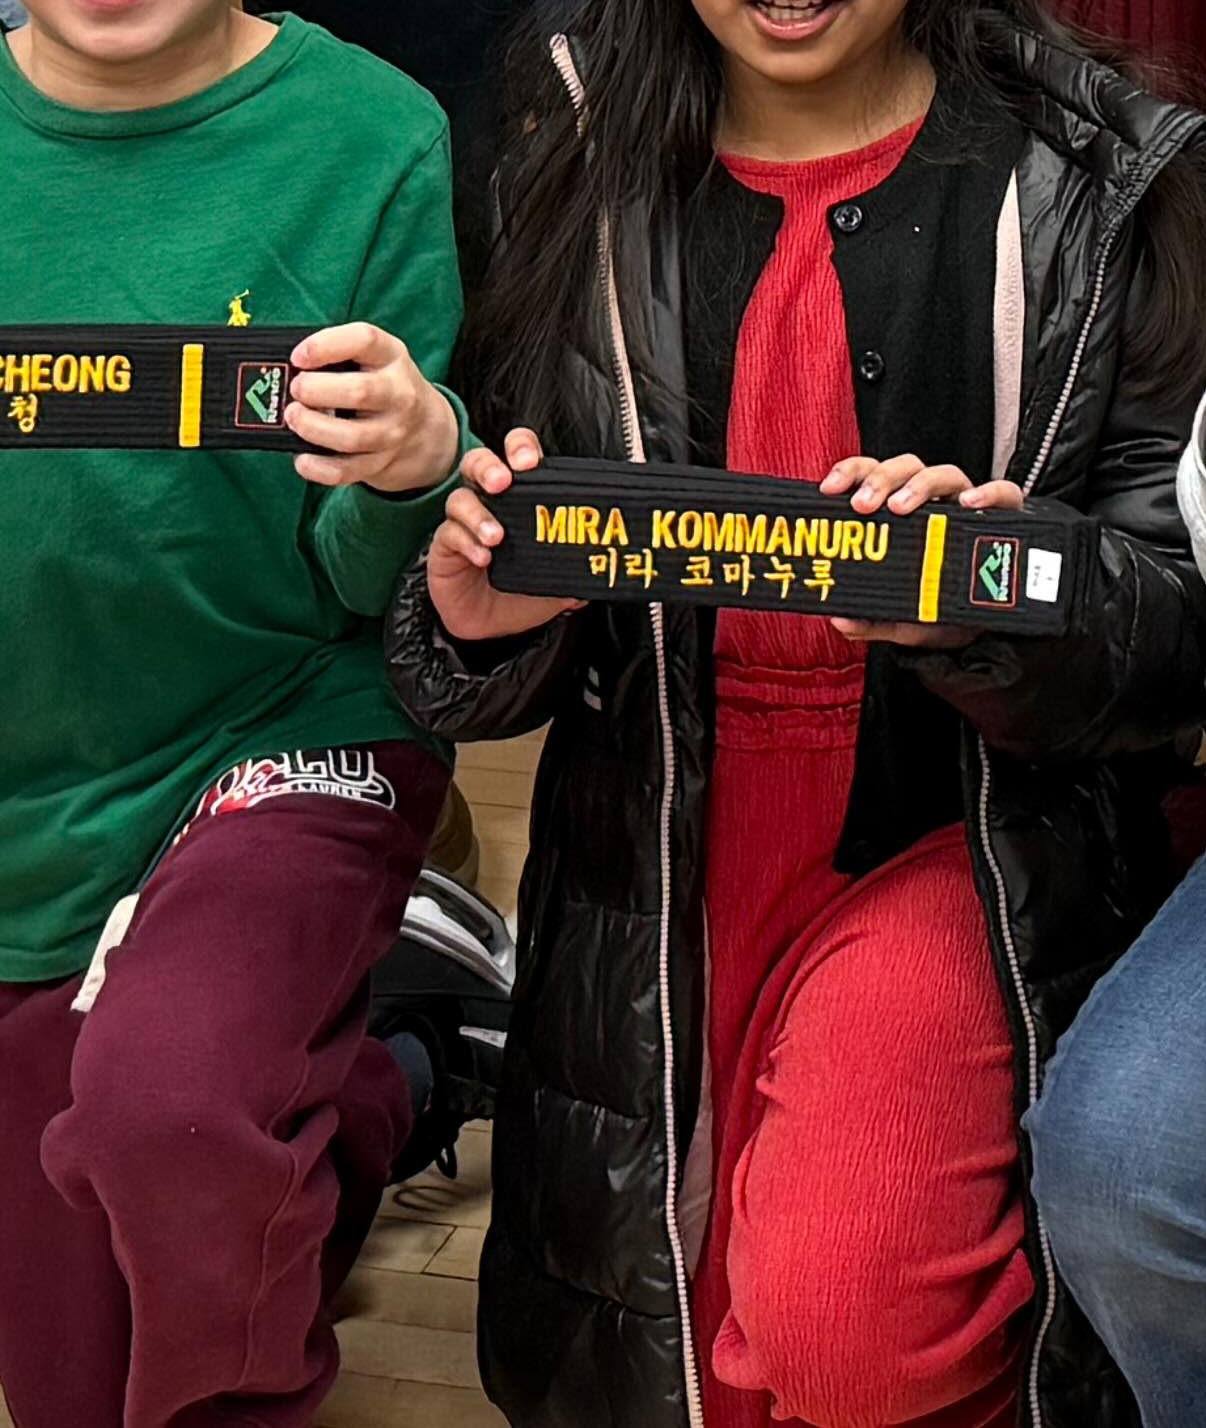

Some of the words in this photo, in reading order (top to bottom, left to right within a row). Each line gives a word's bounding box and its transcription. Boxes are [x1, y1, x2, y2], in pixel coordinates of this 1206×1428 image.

[534, 504, 630, 546] MIRA
[650, 510, 891, 562] KOMMANURU
[588, 546, 660, 589] 미라
[679, 554, 837, 603] 코마누루
